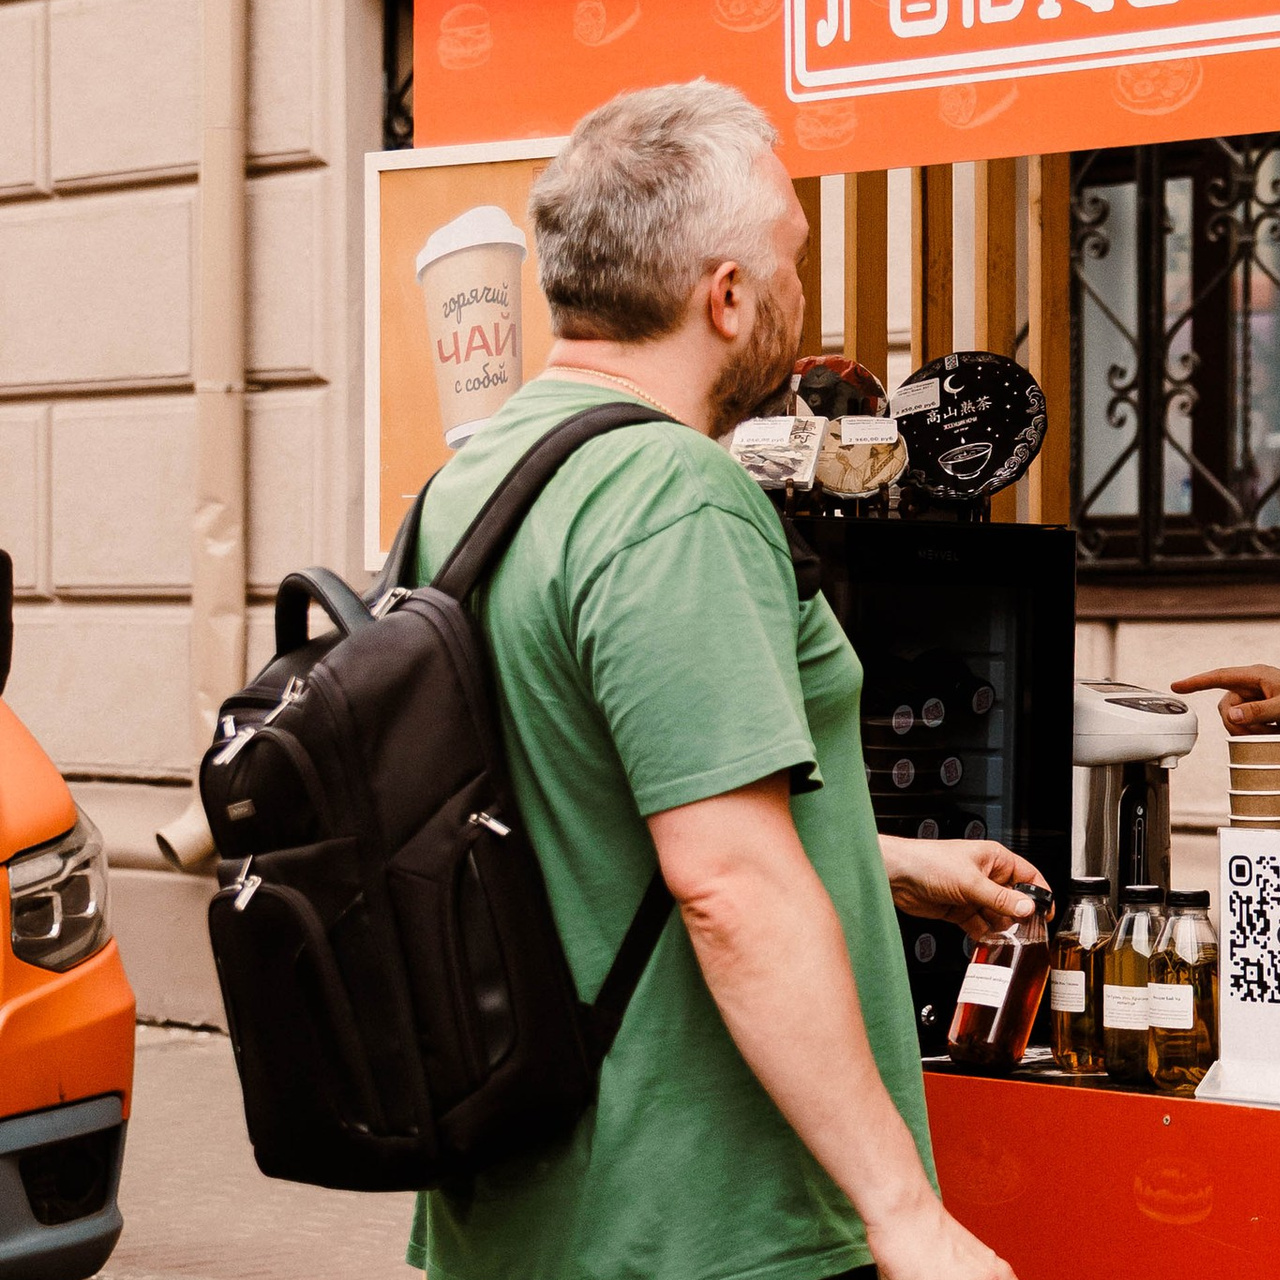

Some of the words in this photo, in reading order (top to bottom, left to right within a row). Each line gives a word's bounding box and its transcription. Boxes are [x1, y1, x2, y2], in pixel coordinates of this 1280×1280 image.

[442, 282, 510, 325] горячий
[437, 312, 517, 365] ЧАЙ
[455, 380, 463, 394] с
[465, 361, 509, 392] собой
